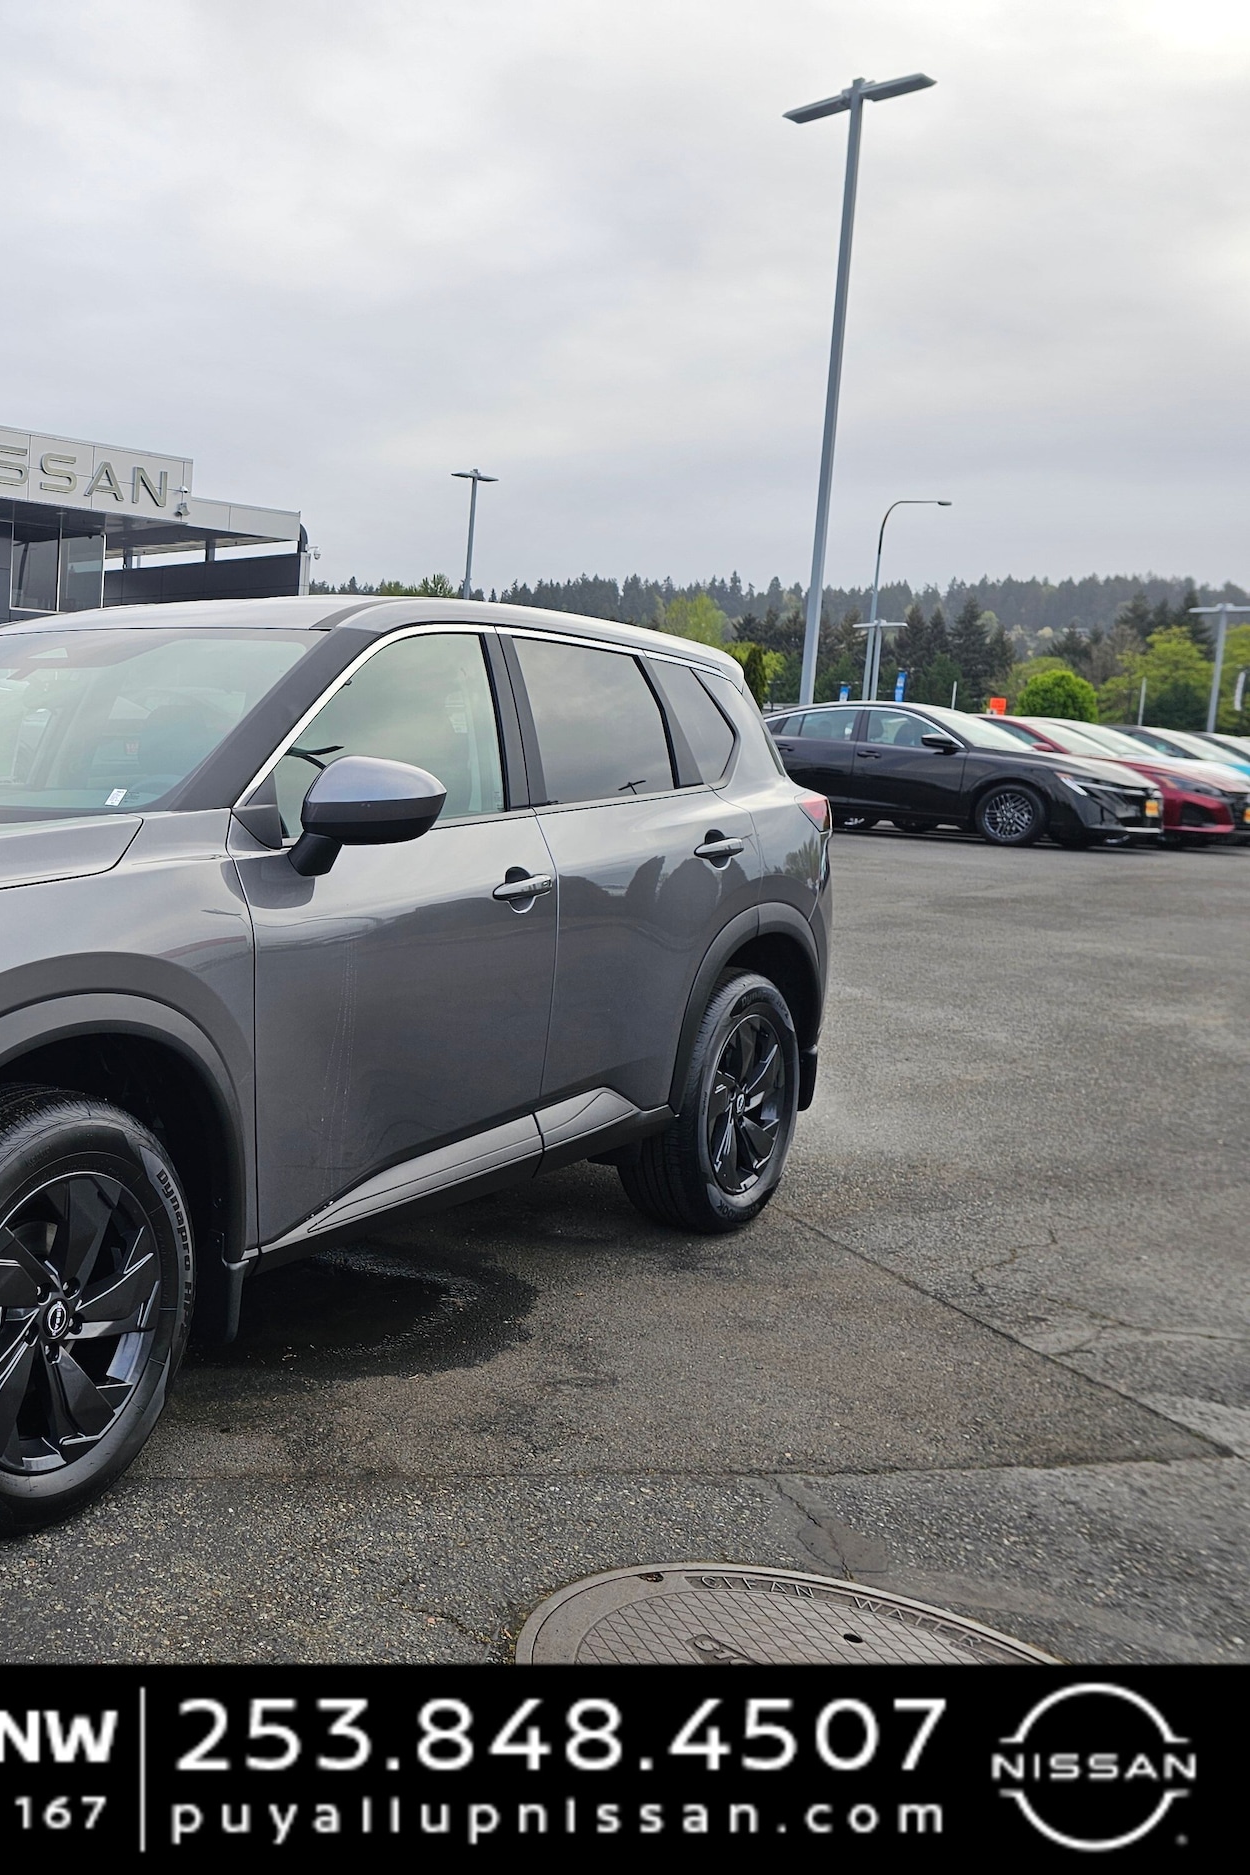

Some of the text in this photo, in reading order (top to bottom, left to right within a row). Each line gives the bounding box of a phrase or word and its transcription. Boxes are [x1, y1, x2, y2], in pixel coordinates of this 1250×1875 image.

[156, 1169, 191, 1271] Dynapro
[701, 1576, 983, 1648] CLEAN WATER
